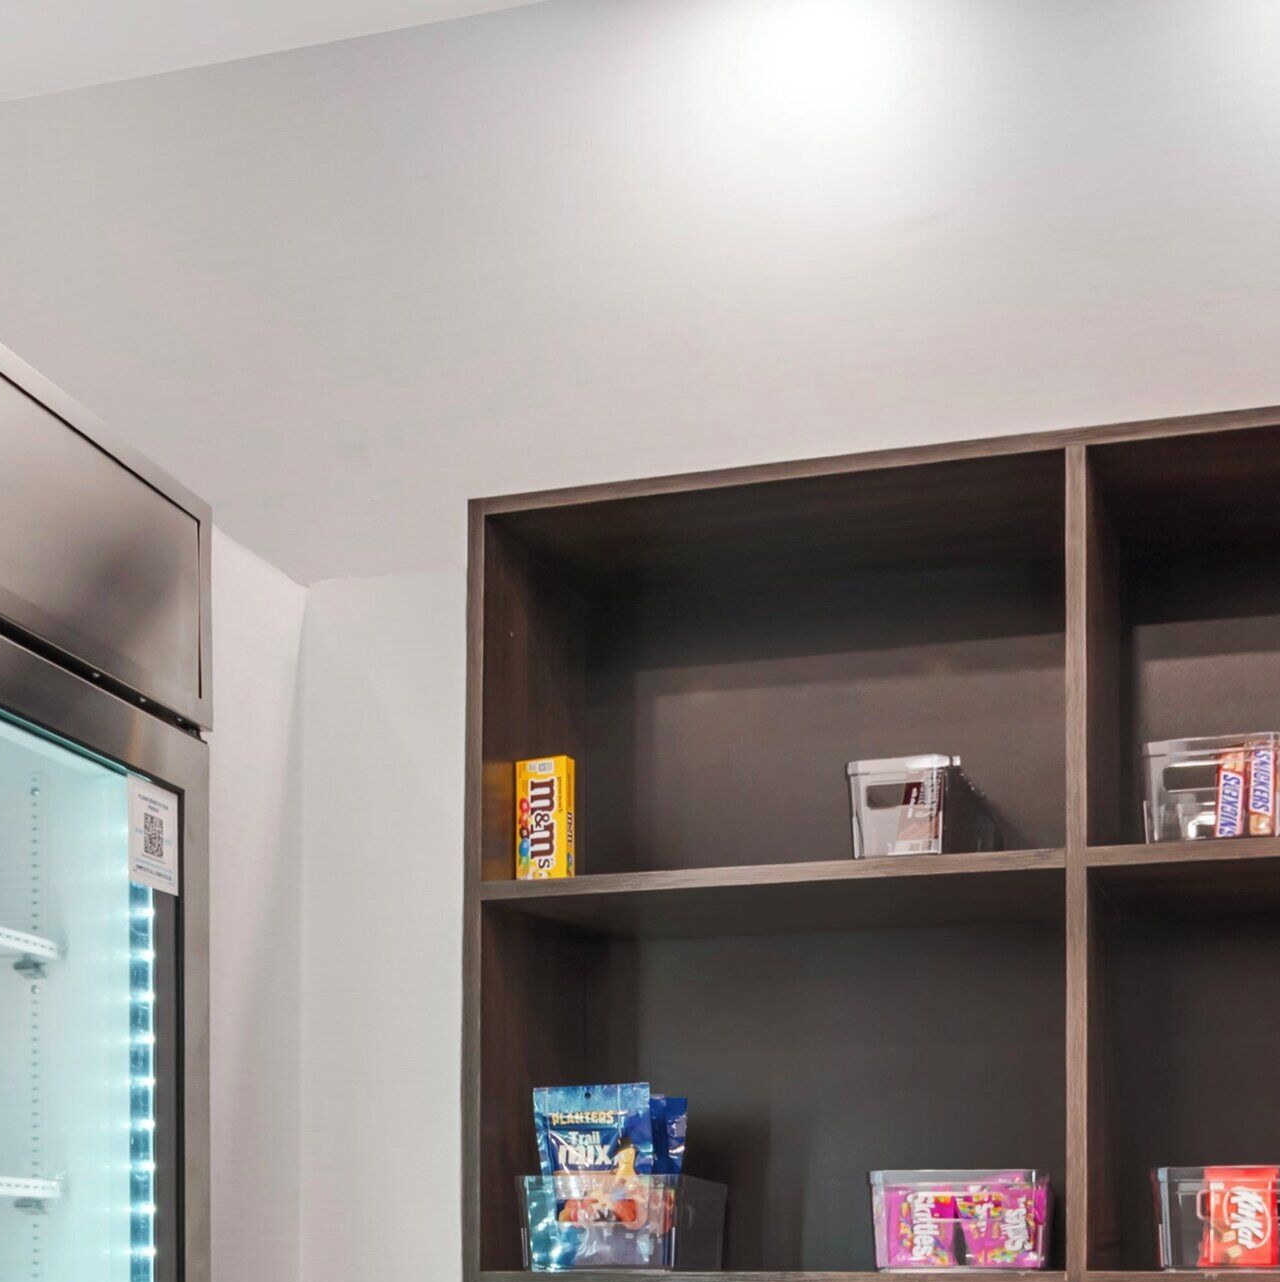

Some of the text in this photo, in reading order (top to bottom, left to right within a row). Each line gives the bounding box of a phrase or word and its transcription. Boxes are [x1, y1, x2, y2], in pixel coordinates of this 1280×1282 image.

[1219, 773, 1241, 838] SNICKERS
[1252, 751, 1271, 813] SNICKERS
[551, 1111, 615, 1126] PLANTERS
[911, 1191, 940, 1259] Skittles
